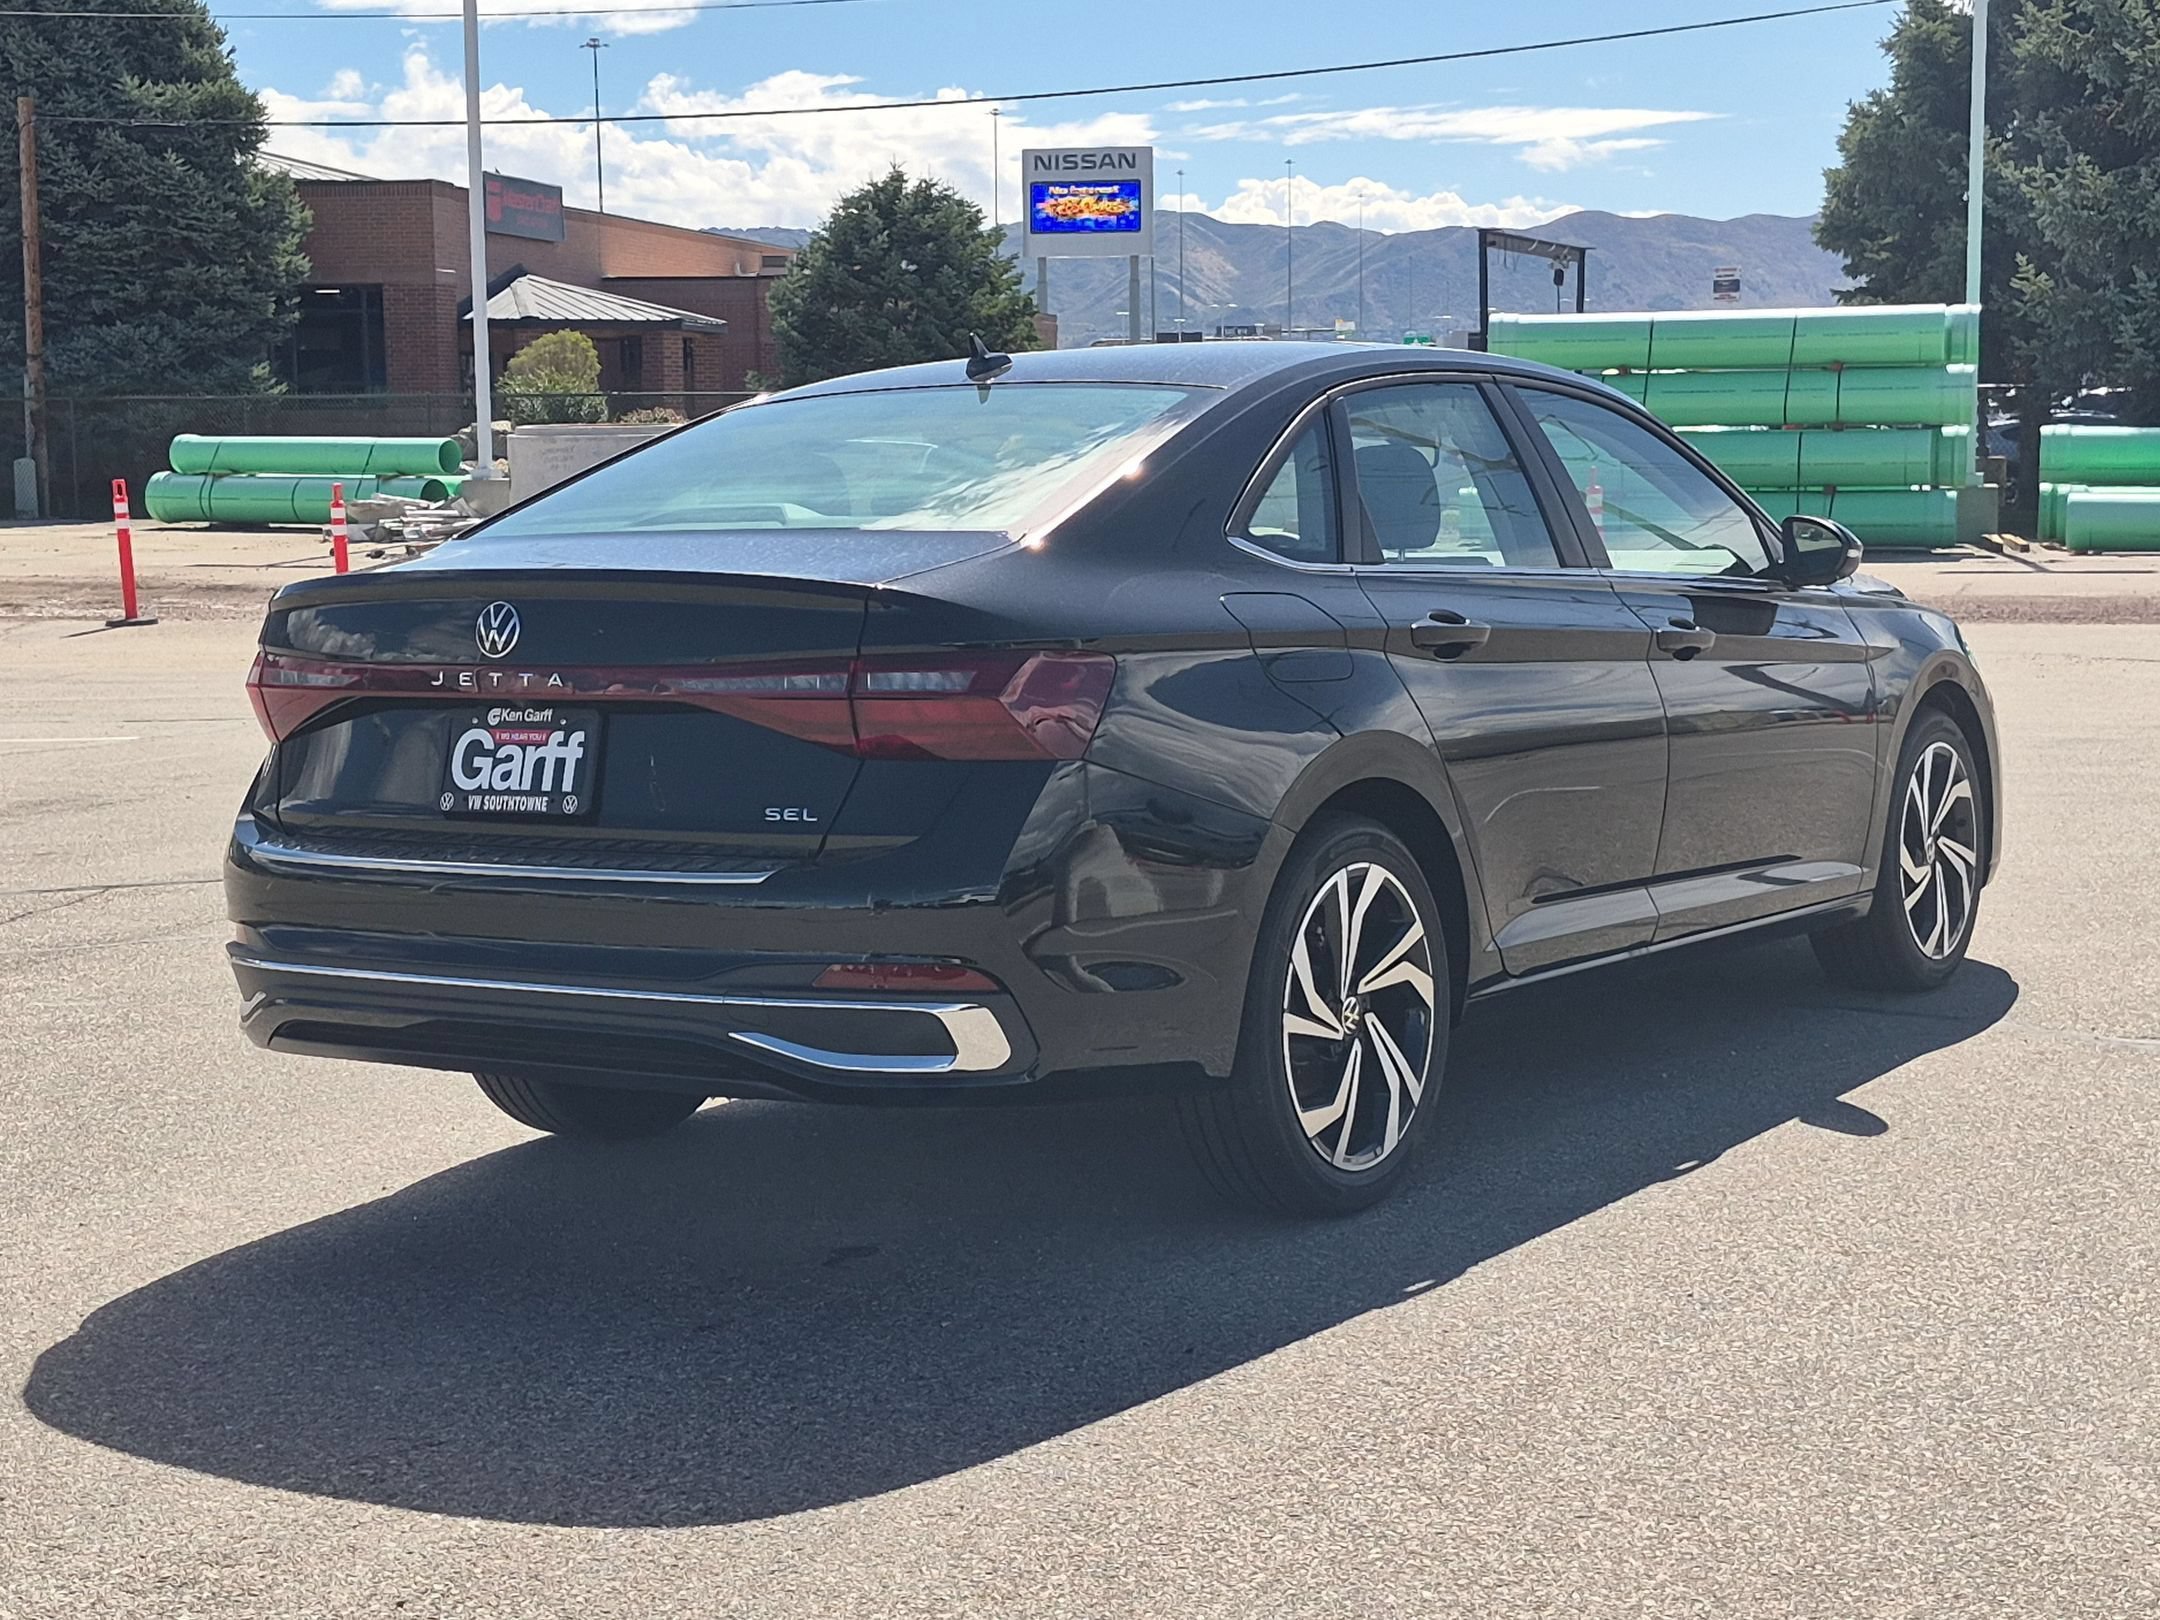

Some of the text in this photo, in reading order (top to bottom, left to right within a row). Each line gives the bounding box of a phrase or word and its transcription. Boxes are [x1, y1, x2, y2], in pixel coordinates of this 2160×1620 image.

[1034, 153, 1136, 171] NISSAN
[431, 671, 563, 686] JETTA
[501, 708, 553, 722] Ken Garff
[451, 728, 585, 792] Garff
[468, 795, 549, 812] VW SOUTHTOWNE
[765, 808, 817, 821] SEL
